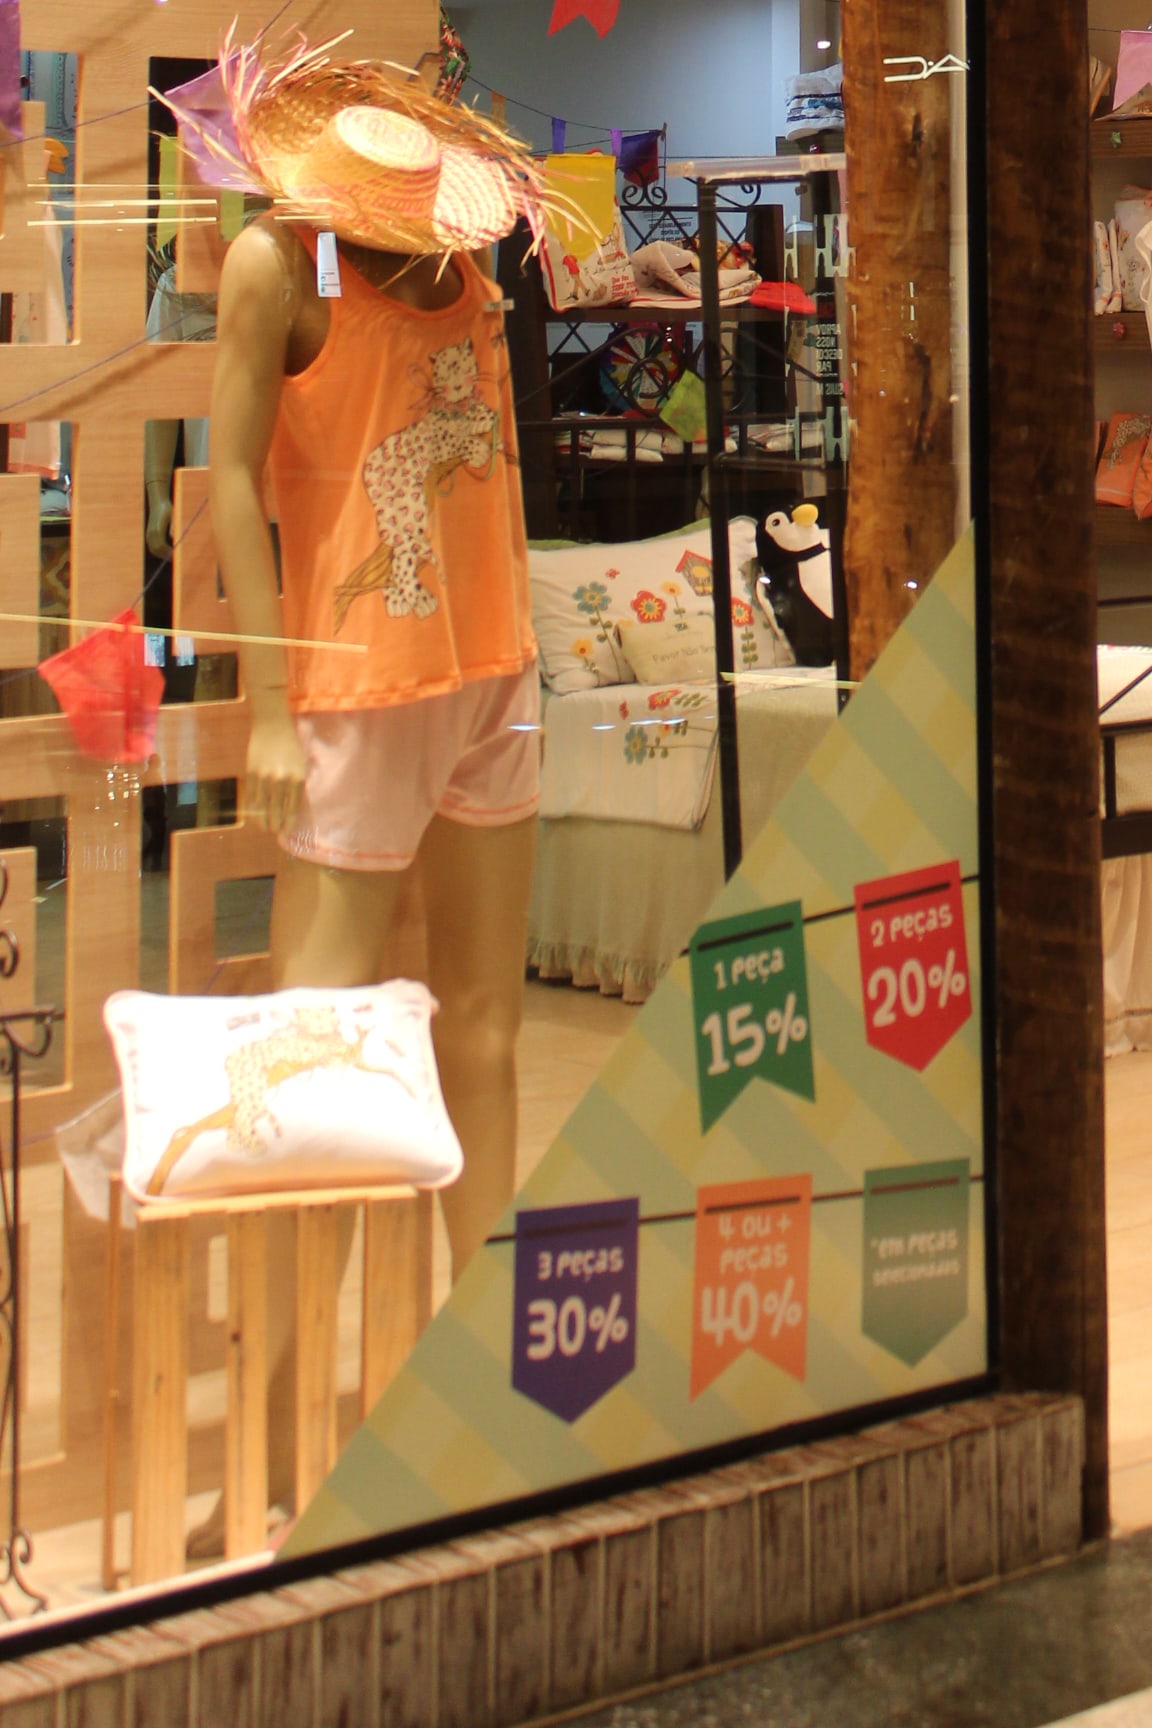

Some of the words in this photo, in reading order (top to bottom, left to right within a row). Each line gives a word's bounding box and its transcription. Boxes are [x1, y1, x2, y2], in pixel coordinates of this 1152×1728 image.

[870, 918, 885, 948] 2
[714, 959, 727, 991] 1
[867, 948, 967, 1029] 20%
[701, 991, 808, 1077] 15%
[537, 1250, 553, 1281] 3
[526, 1291, 630, 1362] 30%
[701, 1275, 803, 1348] 40%
